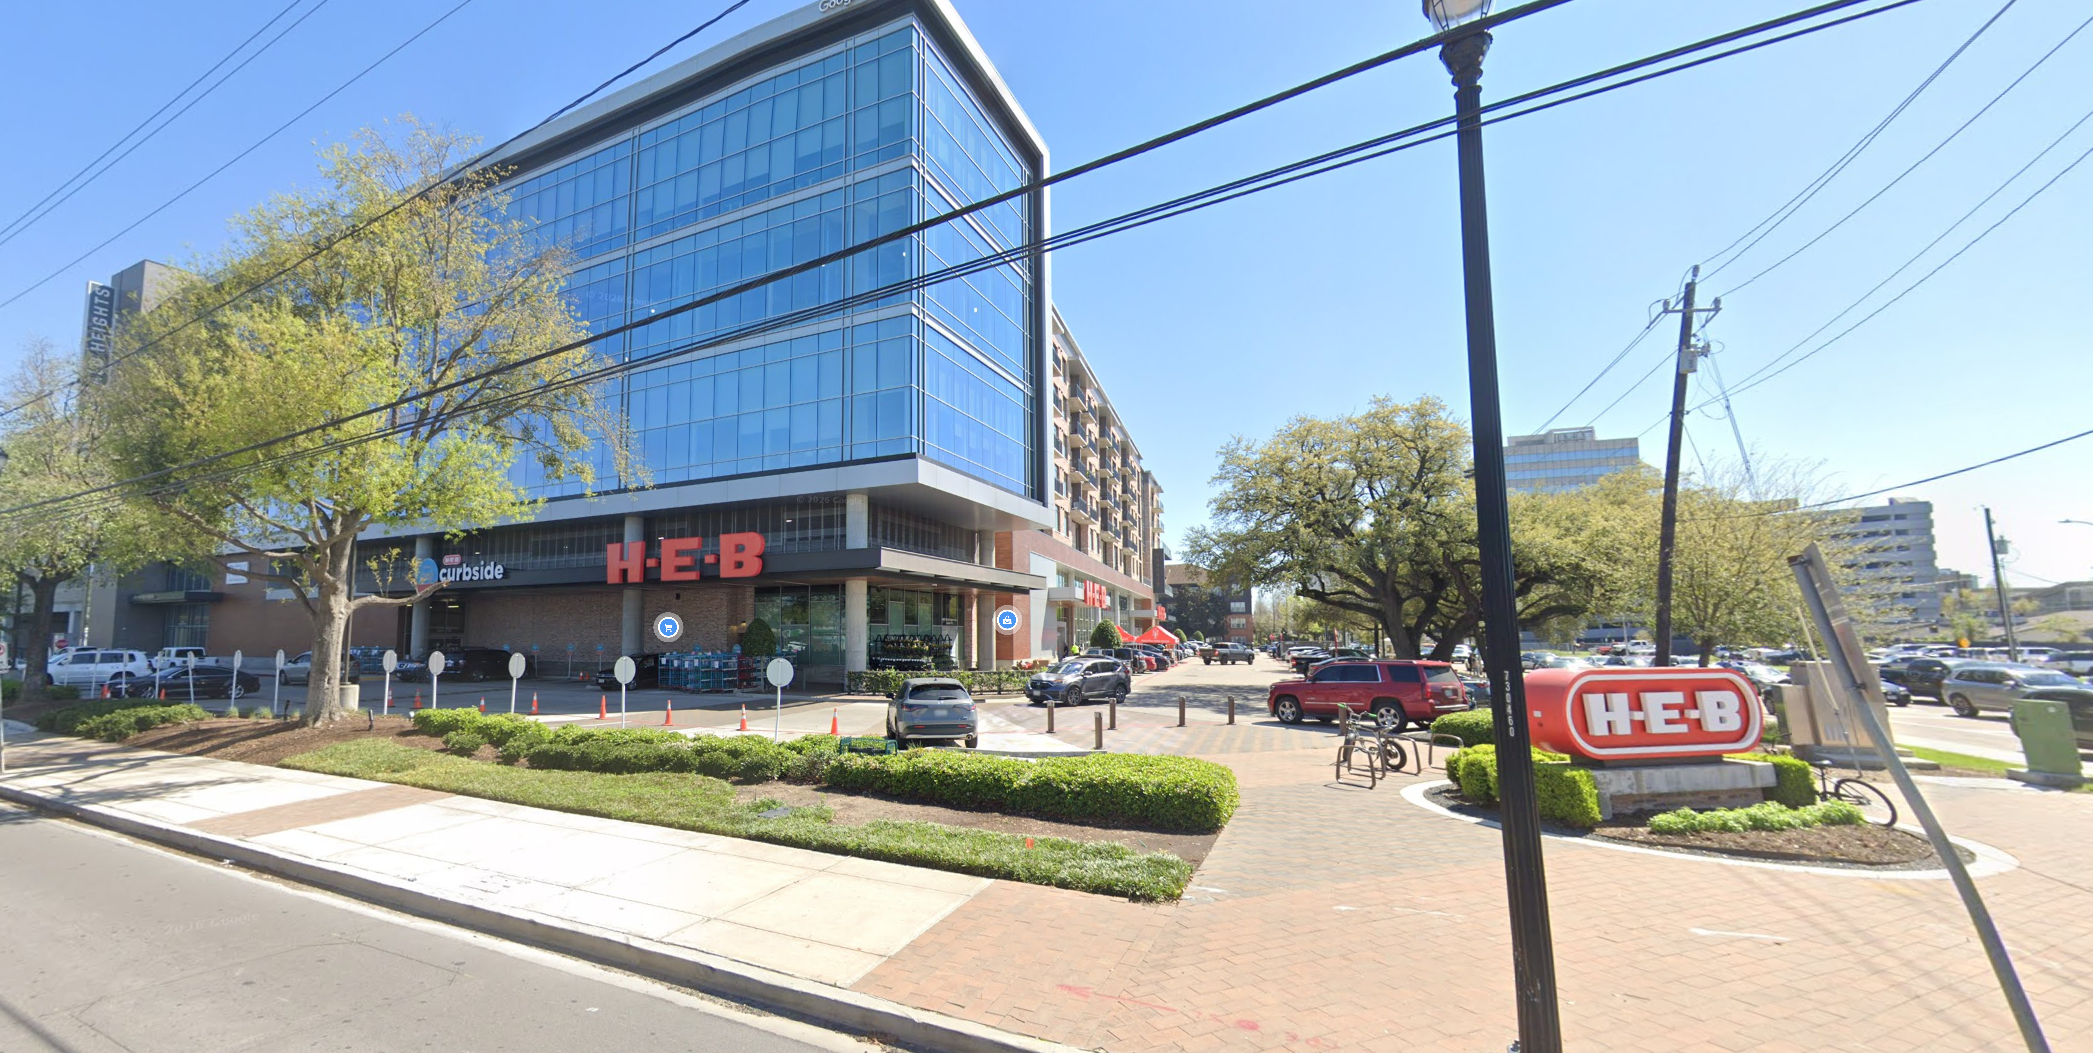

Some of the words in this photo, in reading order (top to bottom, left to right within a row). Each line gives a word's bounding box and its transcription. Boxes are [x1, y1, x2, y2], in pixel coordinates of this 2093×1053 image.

[90, 286, 110, 353] HEIGHTS
[439, 560, 504, 582] curbside
[606, 531, 767, 585] H-E-B
[1503, 670, 1515, 737] 730460
[1582, 689, 1742, 736] H-E-B
